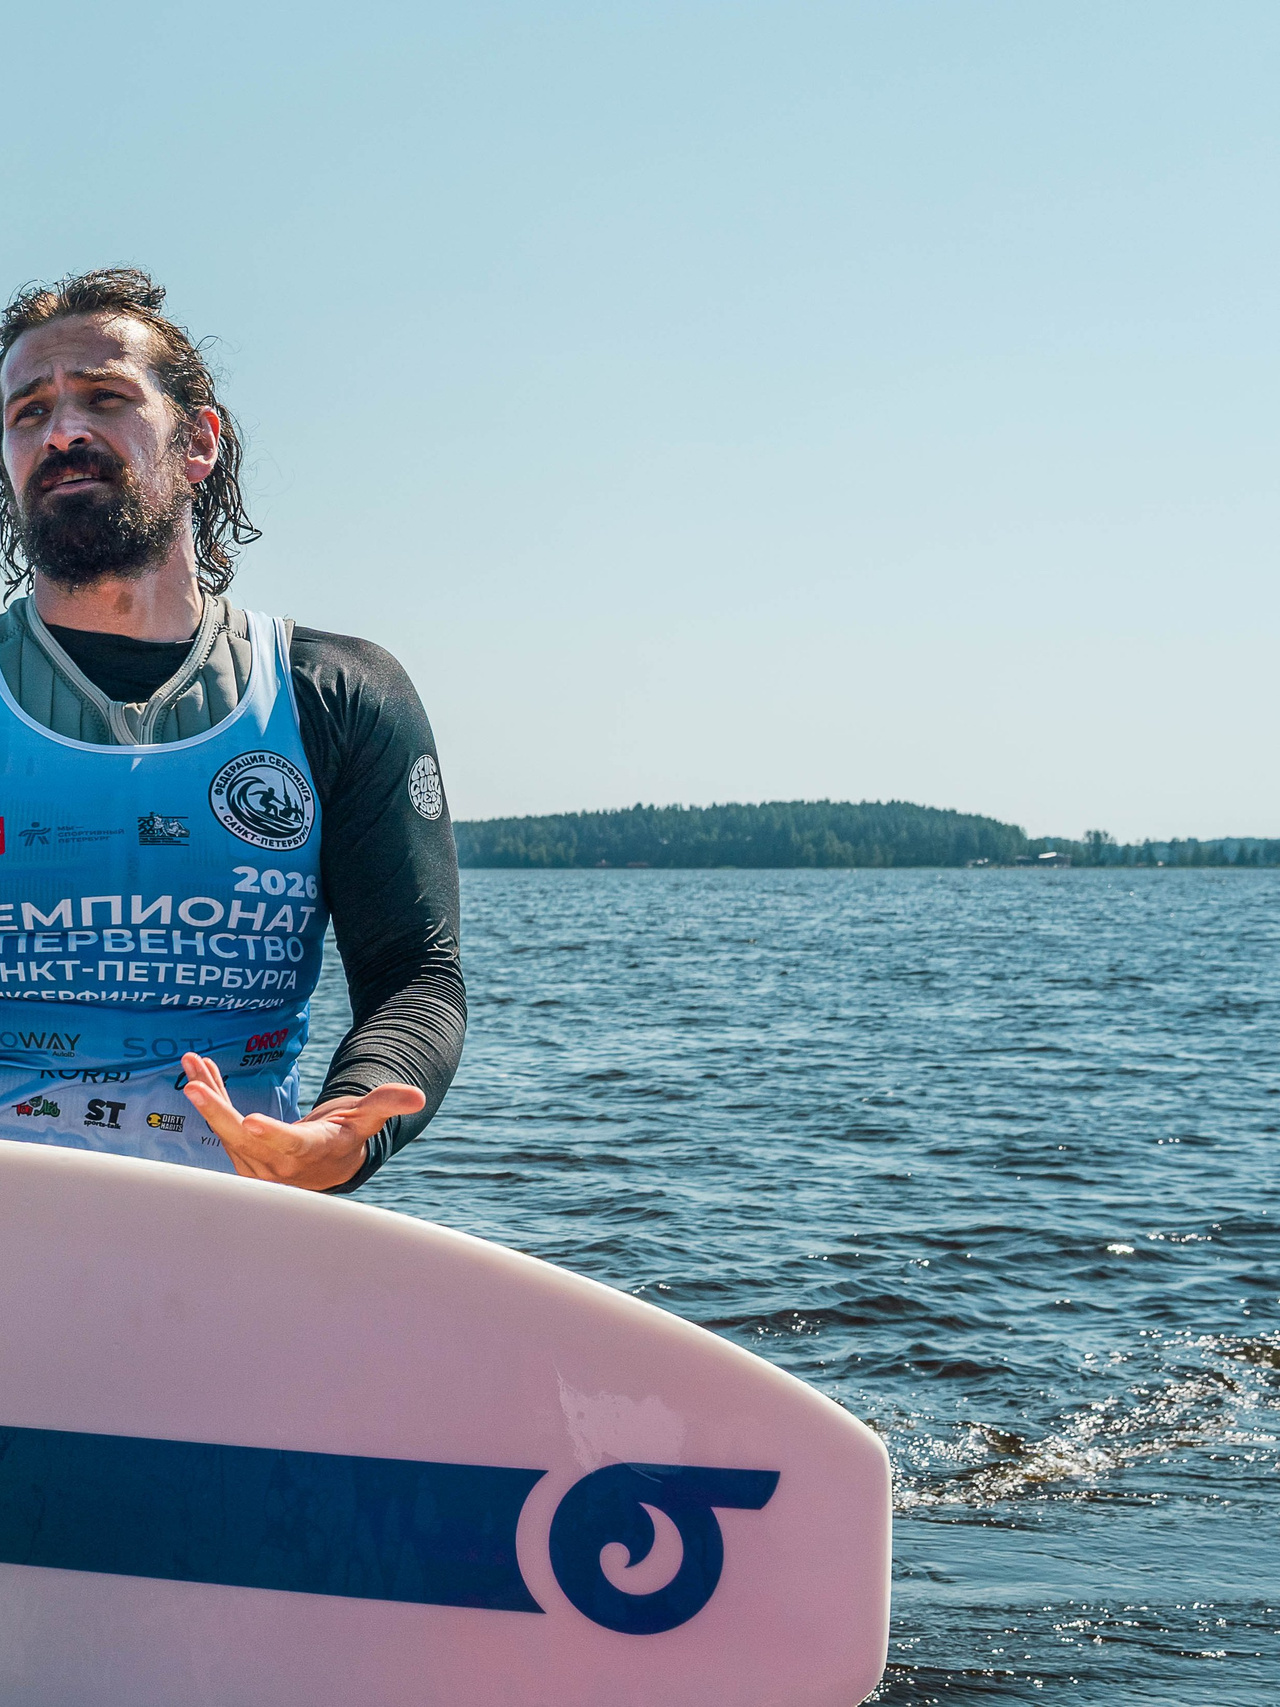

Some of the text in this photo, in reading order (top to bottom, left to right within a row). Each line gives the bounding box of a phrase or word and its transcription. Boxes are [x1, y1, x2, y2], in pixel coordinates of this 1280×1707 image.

[214, 755, 311, 802] ФЕДЕРАЦИЯ СЕРФИНГА
[58, 835, 111, 844] ПЕТЕРБУРГ
[223, 815, 309, 848] САНКТ-ПЕТЕРБУРГА
[232, 865, 318, 899] 2026
[161, 993, 180, 1006] И
[245, 1028, 289, 1052] DROP
[85, 1098, 126, 1125] ST
[161, 1114, 184, 1124] DIRTY
